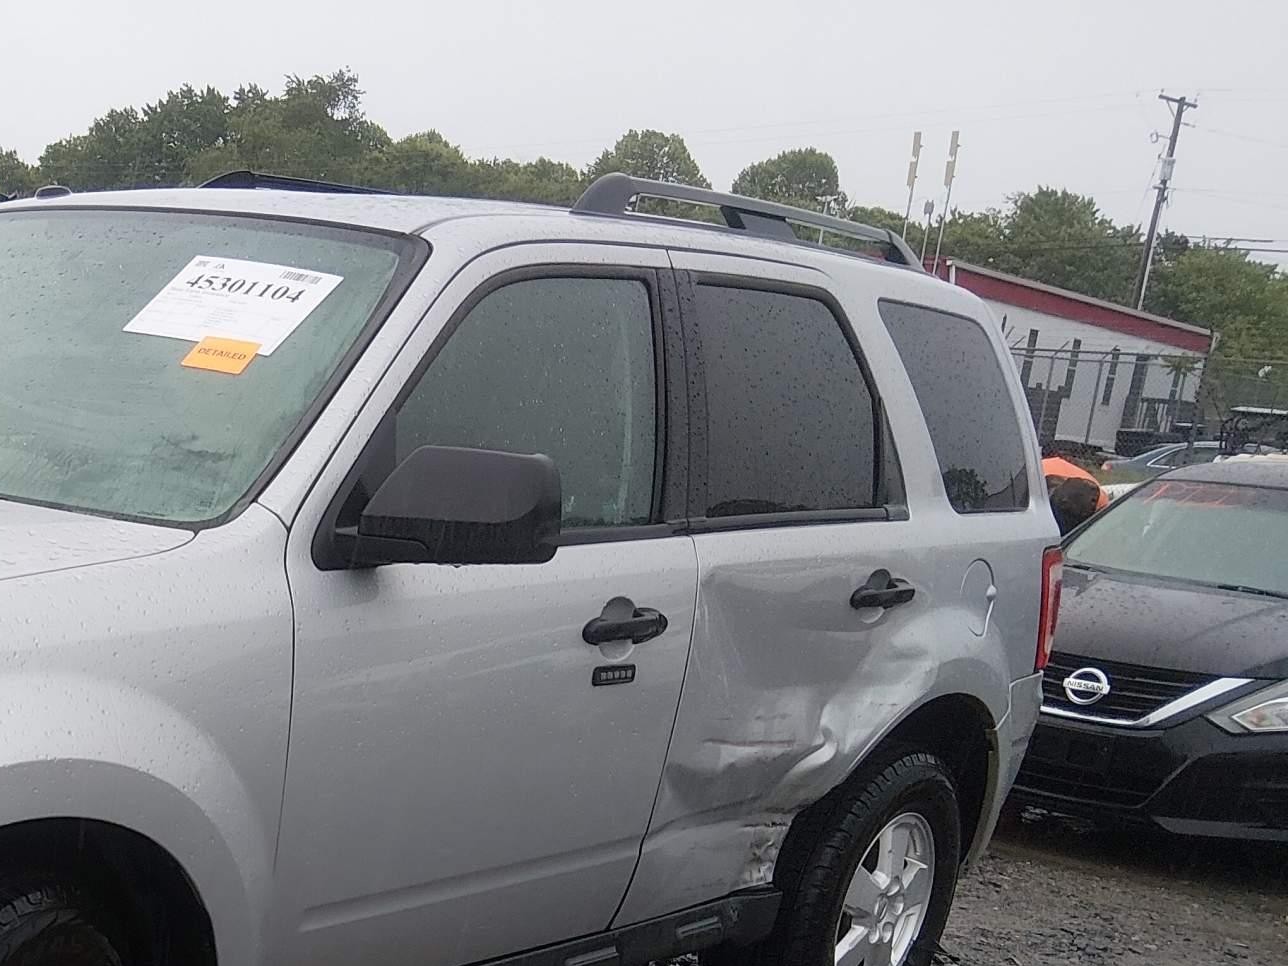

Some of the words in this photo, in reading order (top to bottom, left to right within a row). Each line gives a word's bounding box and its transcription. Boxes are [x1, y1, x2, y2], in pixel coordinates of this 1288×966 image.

[185, 273, 306, 304] 45301104
[197, 346, 247, 361] DETAILED
[1066, 680, 1104, 692] NISSAN
